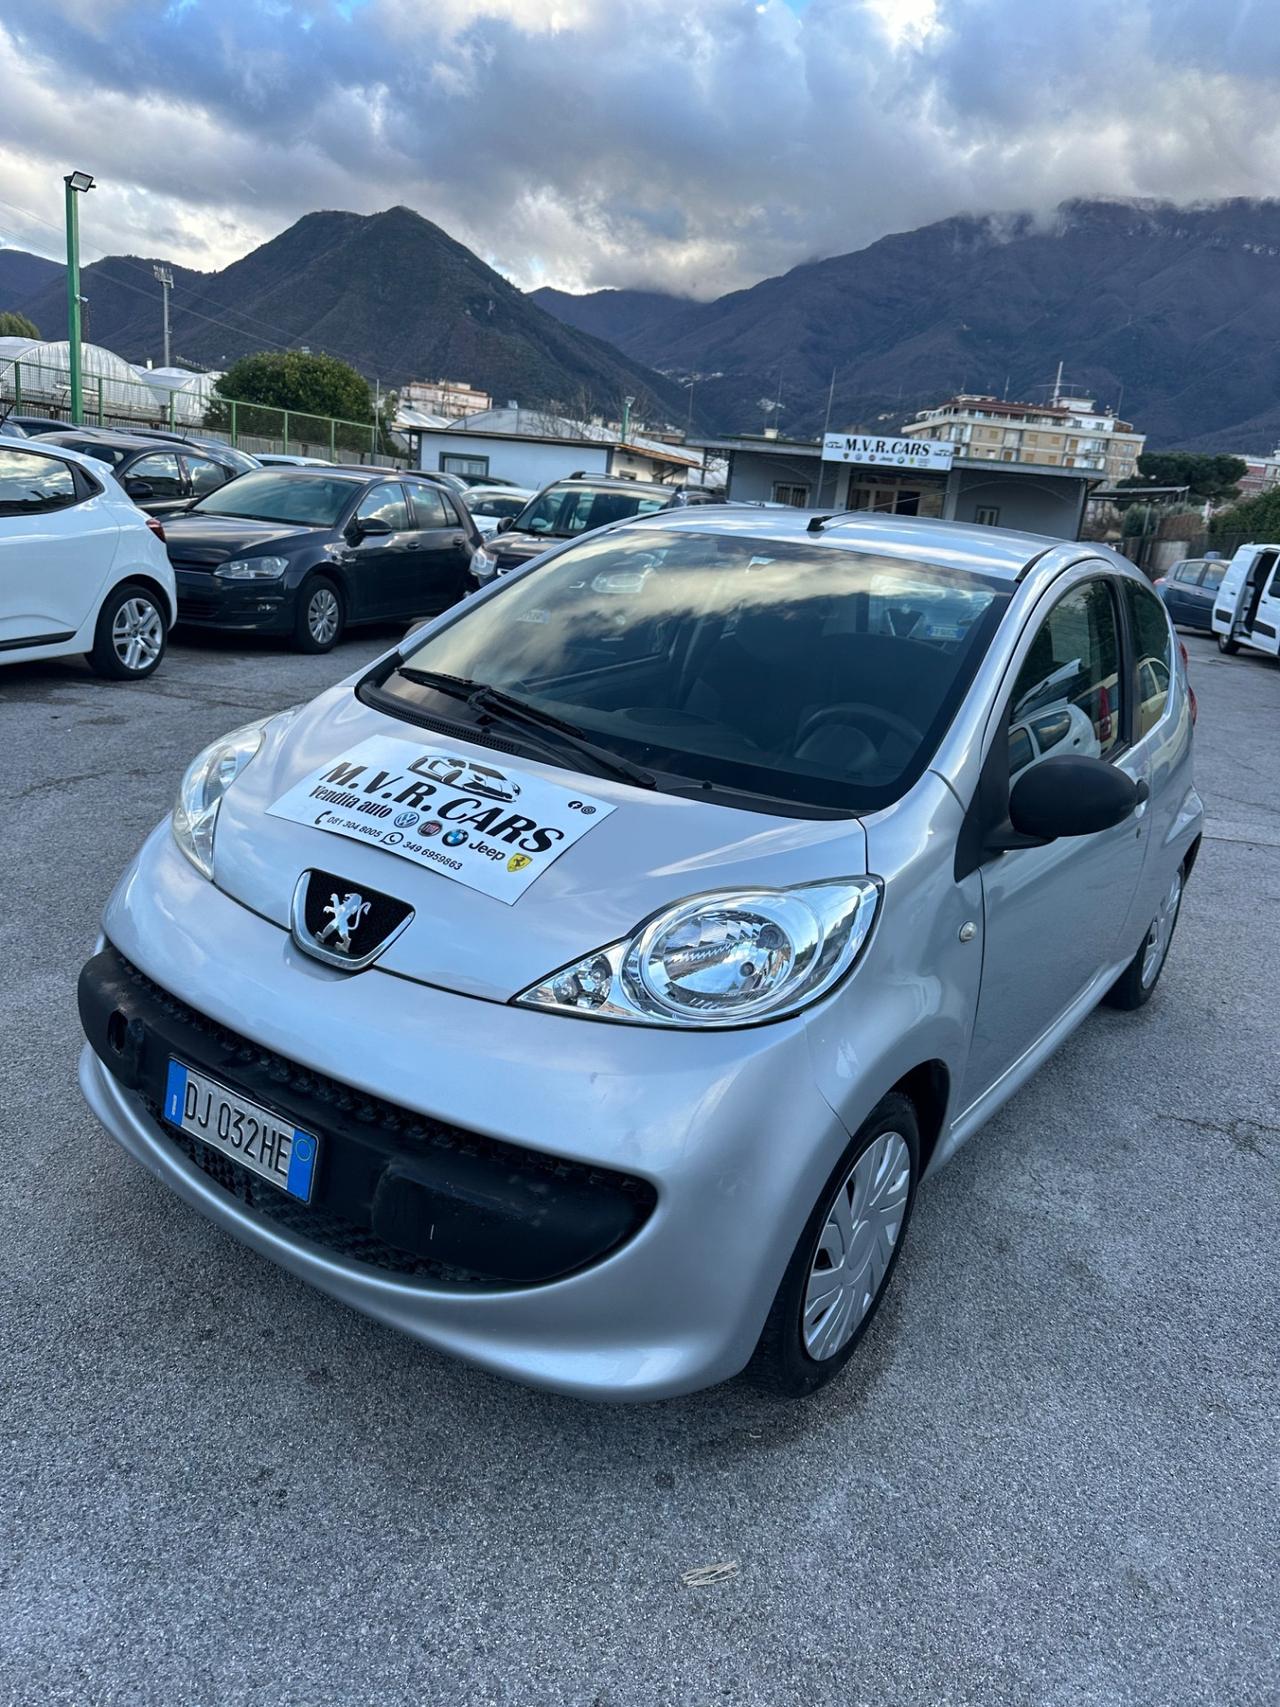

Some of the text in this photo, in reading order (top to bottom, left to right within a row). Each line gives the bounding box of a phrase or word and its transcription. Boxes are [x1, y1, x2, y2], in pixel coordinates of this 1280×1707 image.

[309, 785, 393, 818] Vendita auto
[326, 816, 383, 837] 081 304 8005
[402, 841, 463, 870] 349 6959863
[468, 841, 505, 861] Jeep
